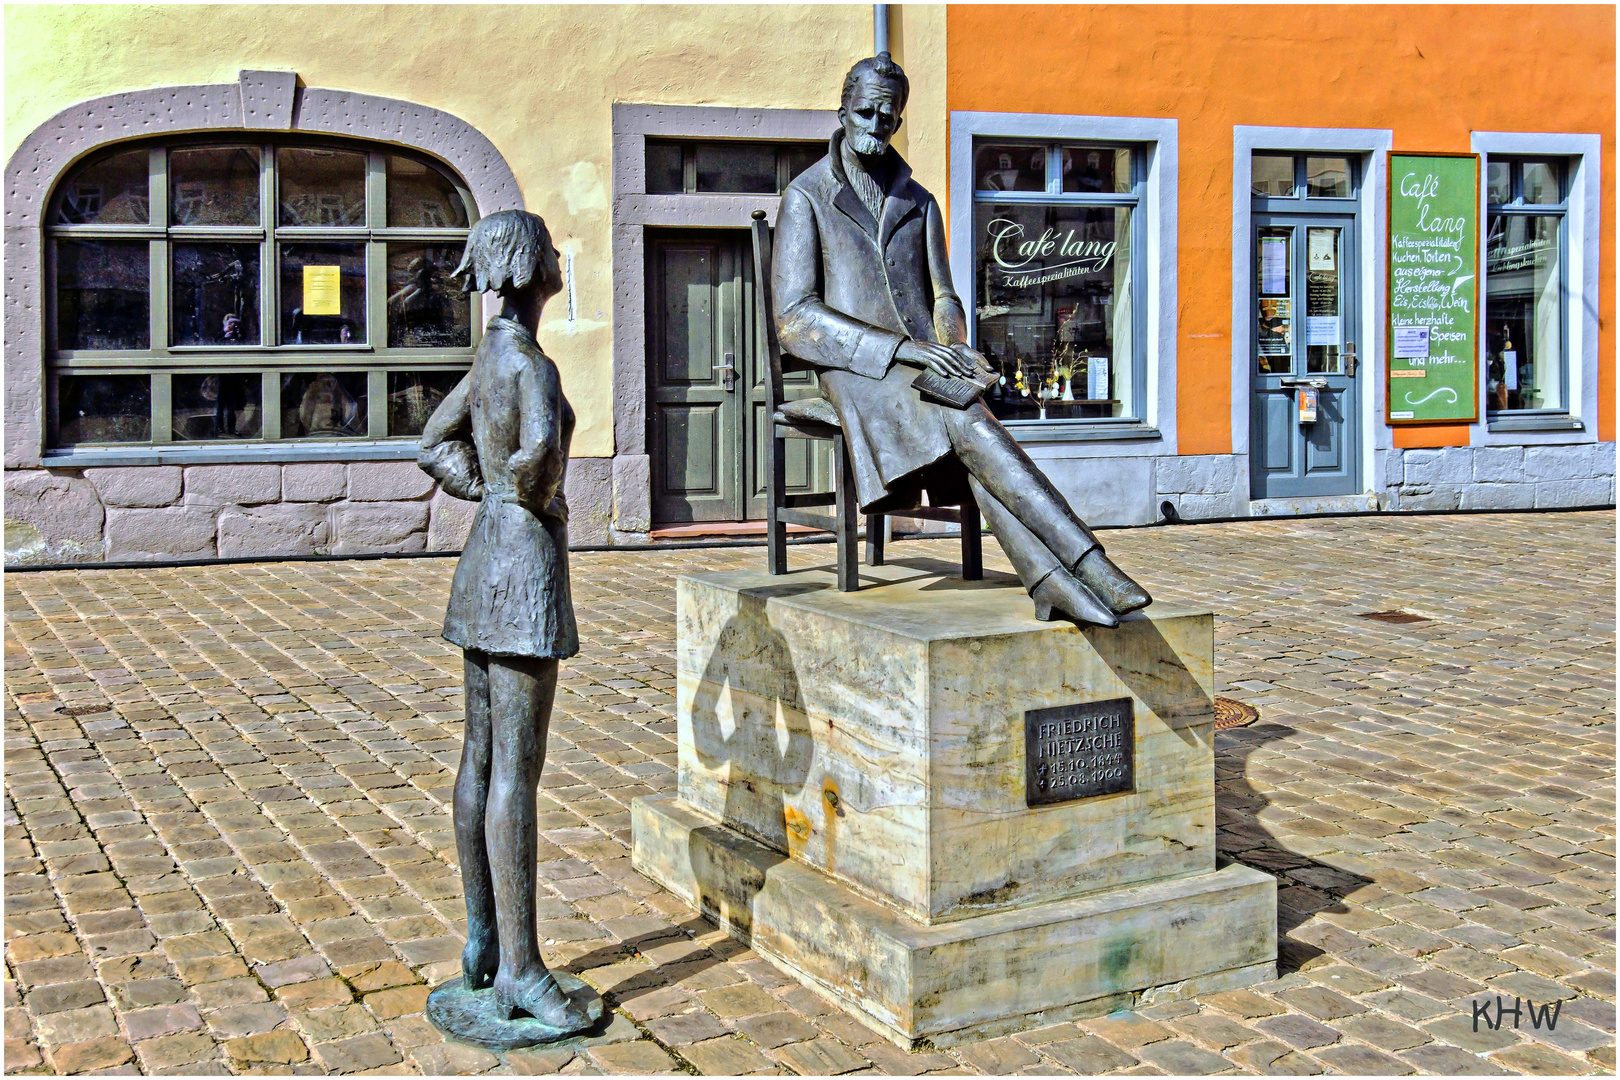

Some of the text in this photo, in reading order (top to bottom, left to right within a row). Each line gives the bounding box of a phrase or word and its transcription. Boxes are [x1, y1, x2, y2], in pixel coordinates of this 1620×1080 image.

[1400, 171, 1439, 210] Café
[1416, 203, 1466, 252] lang
[987, 218, 1119, 273] Café lang
[1391, 234, 1459, 253] Kaffeespezialitäten
[1392, 248, 1452, 263] Kuchen, Torten
[1002, 266, 1091, 289] Kaffeespezialitäten
[1393, 277, 1452, 297] Herstellung
[1393, 294, 1411, 310] Eis,
[1440, 292, 1471, 313] Wein
[1414, 311, 1455, 326] herzhafte
[1430, 325, 1467, 346] Speisen
[1039, 714, 1121, 739] FRIEDRICH
[1039, 732, 1122, 758] NIETZSCHE
